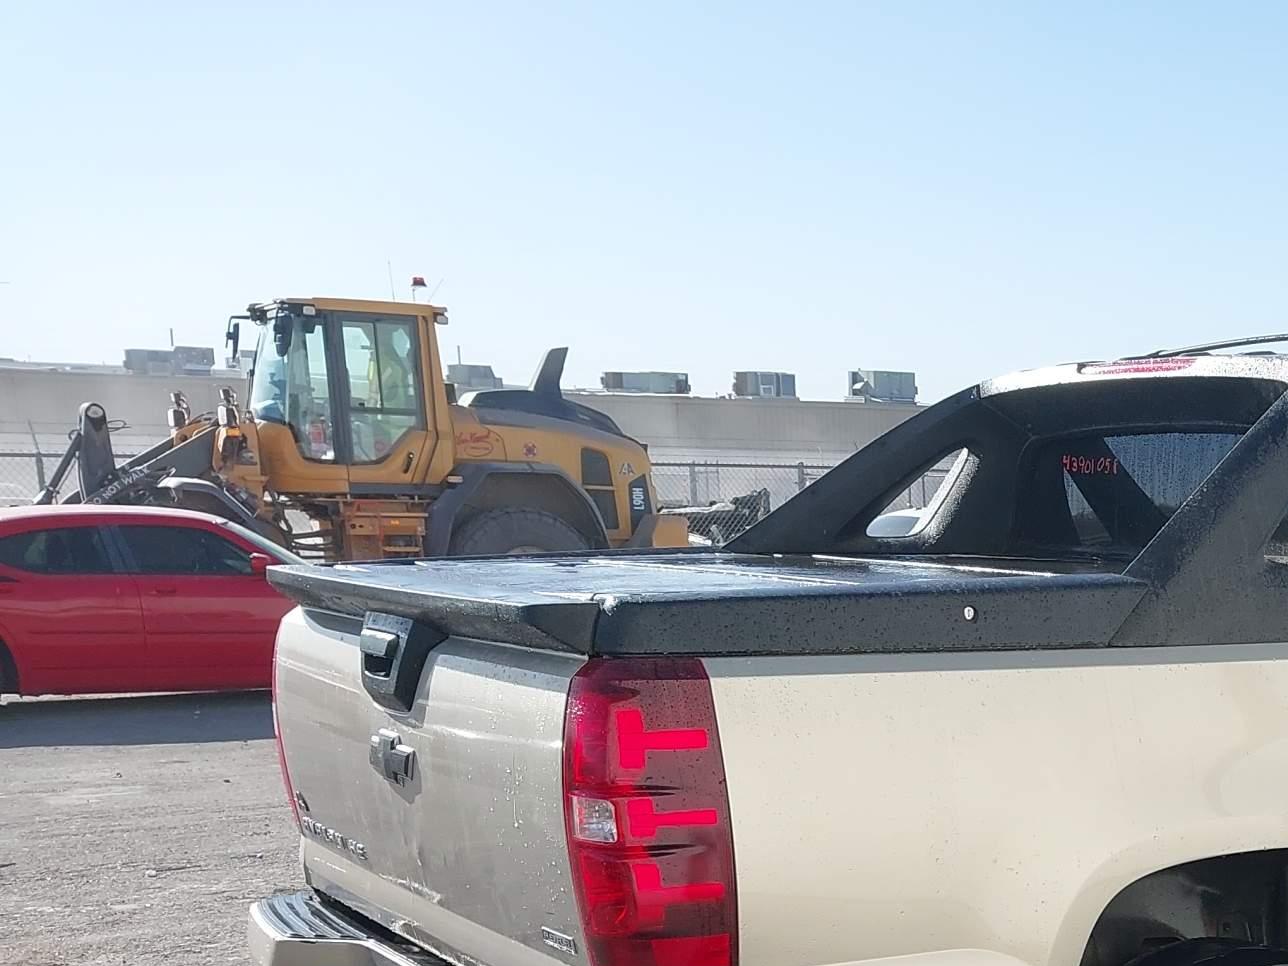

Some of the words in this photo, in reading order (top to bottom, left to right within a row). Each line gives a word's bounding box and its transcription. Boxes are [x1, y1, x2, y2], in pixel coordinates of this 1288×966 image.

[102, 480, 120, 500] NOT
[121, 465, 151, 486] WALK
[632, 487, 645, 511] L90H
